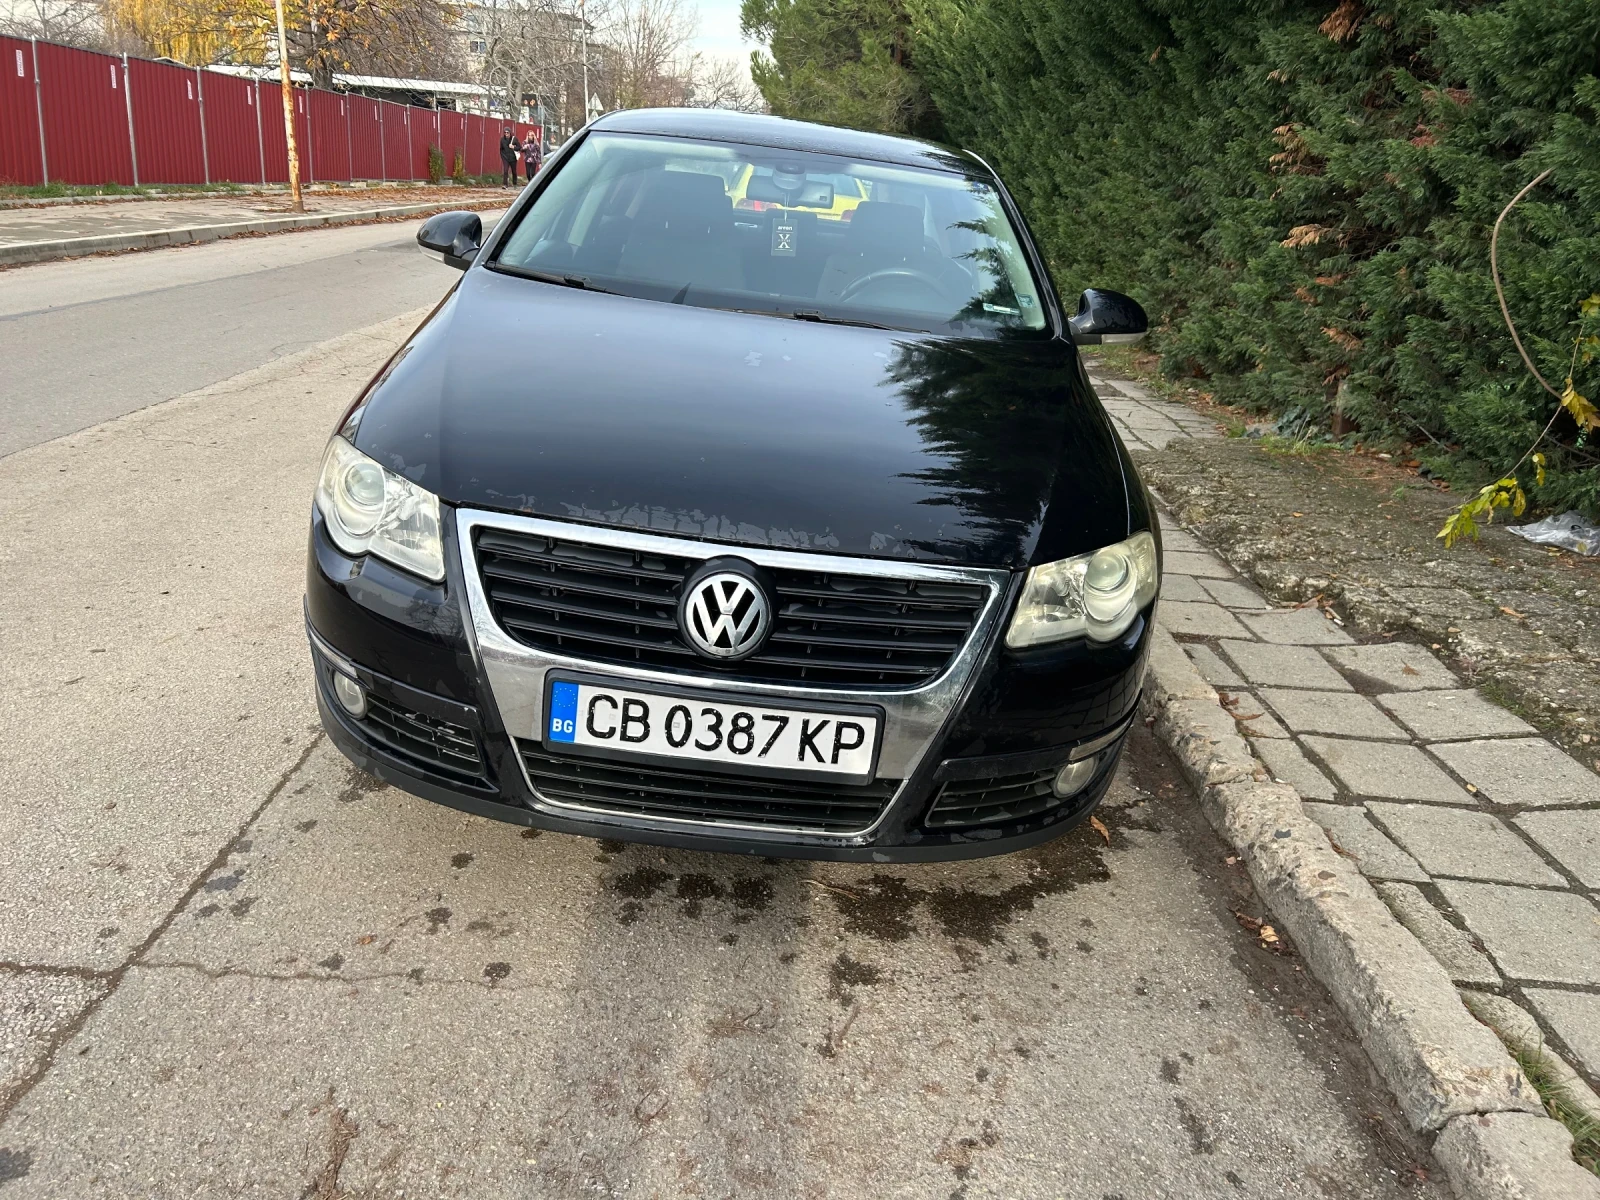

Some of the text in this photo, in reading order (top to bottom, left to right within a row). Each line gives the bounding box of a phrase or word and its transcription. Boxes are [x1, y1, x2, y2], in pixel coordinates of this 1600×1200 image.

[552, 718, 574, 733] BG
[586, 694, 866, 764] CB 0387 KP
